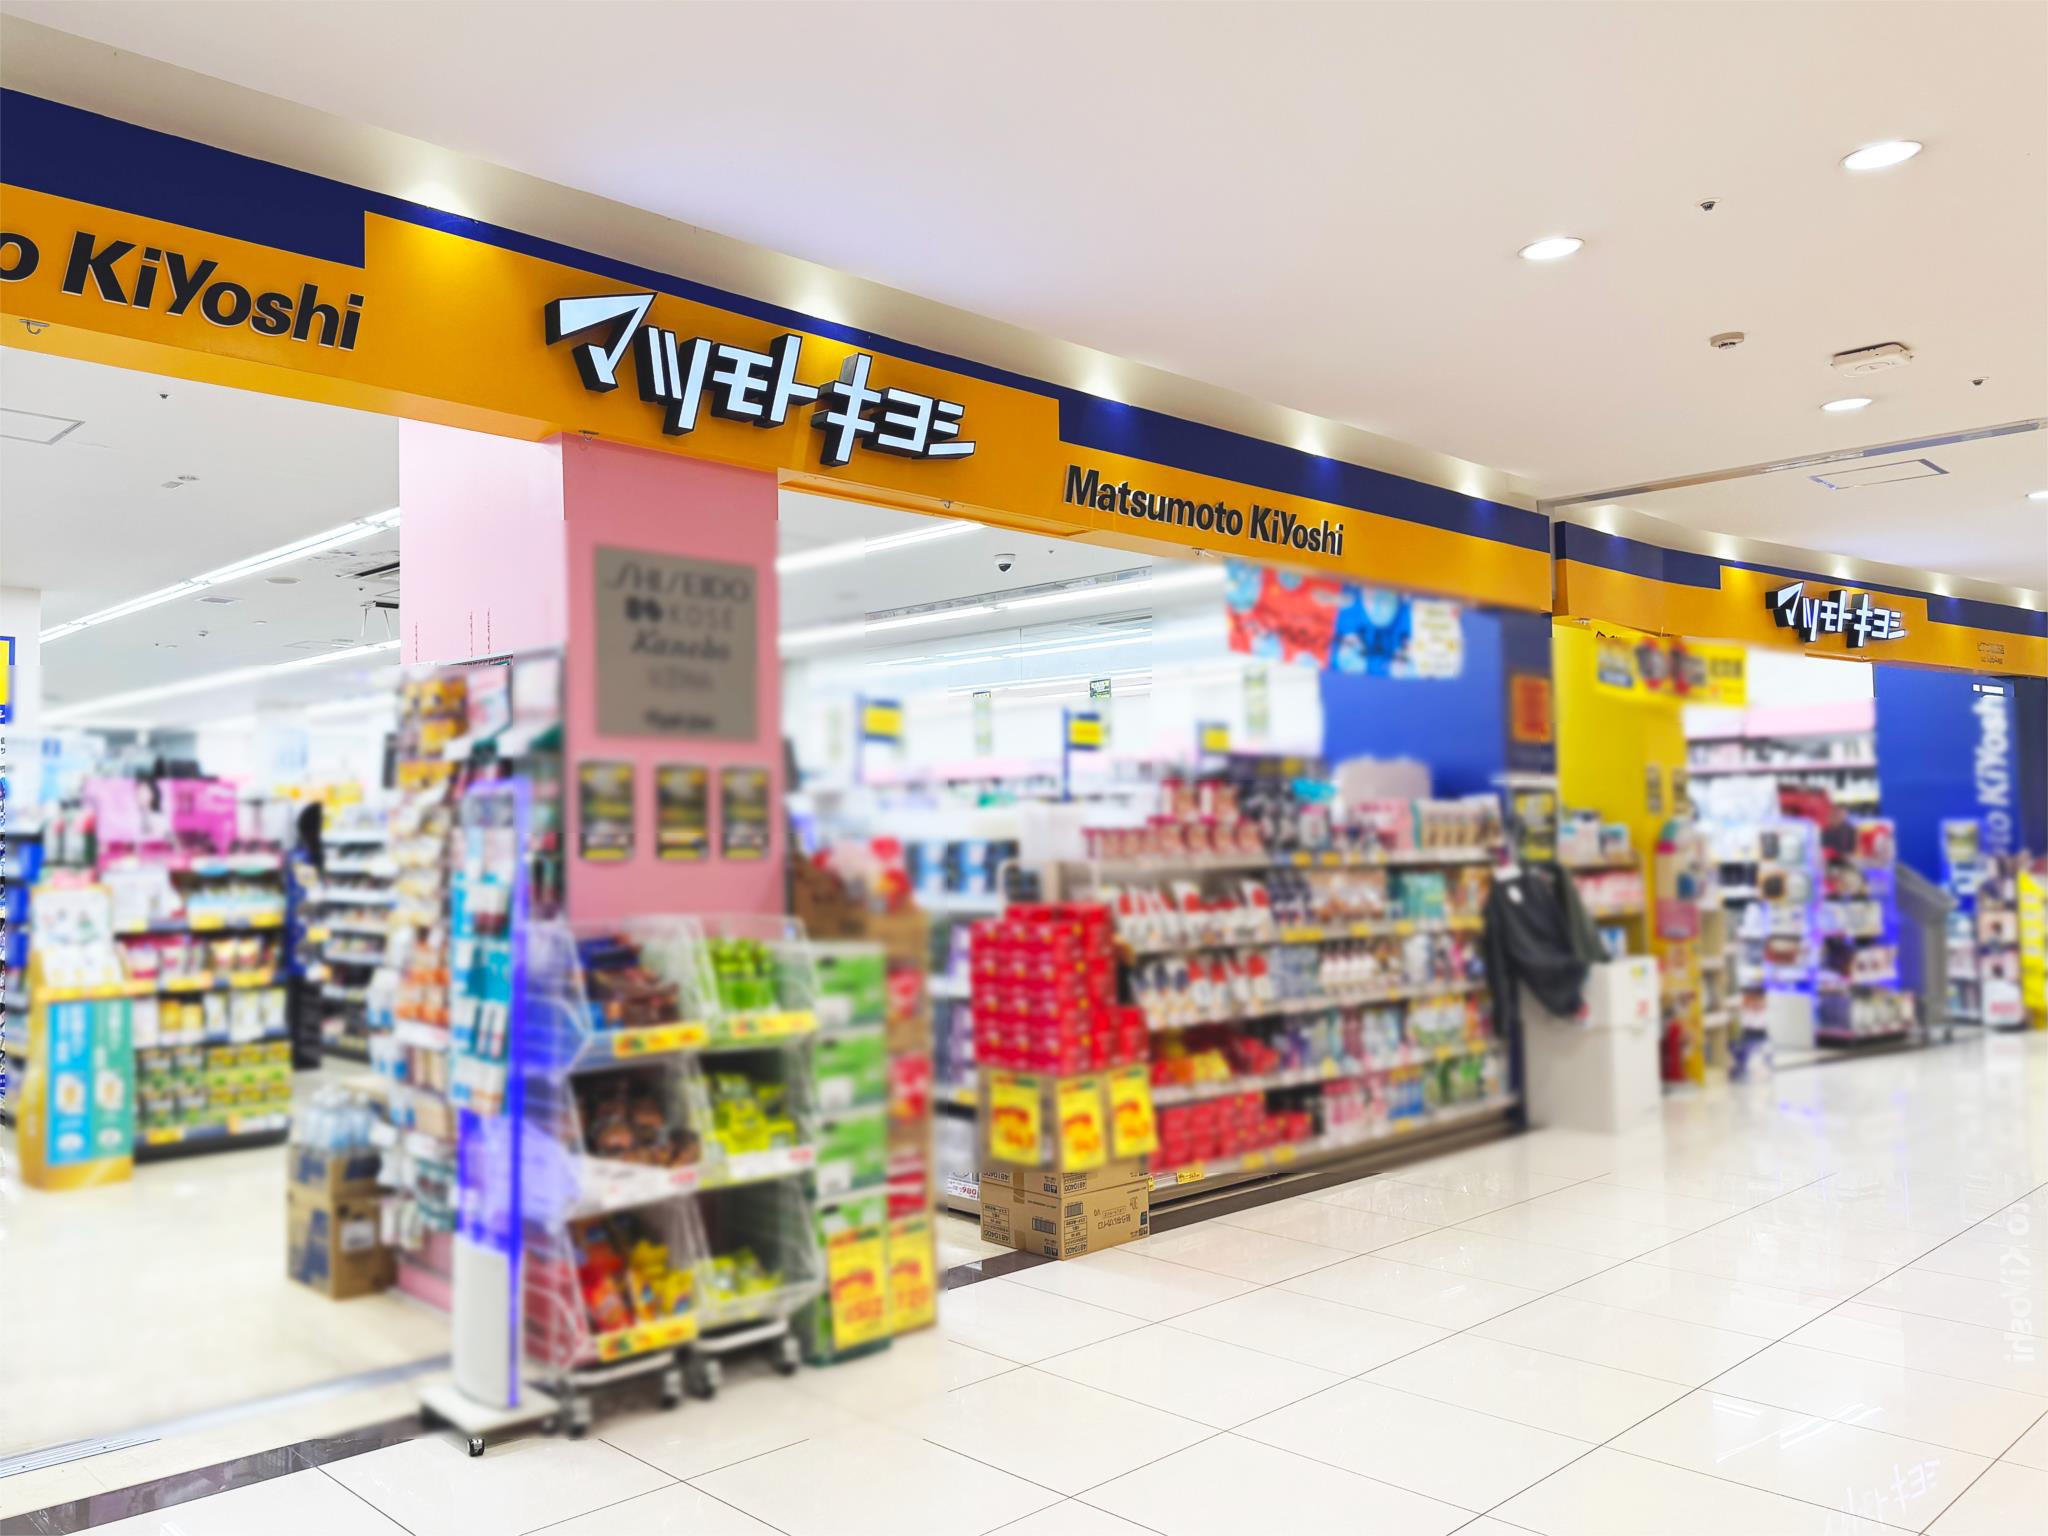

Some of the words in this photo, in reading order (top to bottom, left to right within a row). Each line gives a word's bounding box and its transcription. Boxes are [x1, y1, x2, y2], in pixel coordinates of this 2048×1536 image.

[61, 231, 365, 352] KiYoshi
[546, 291, 977, 467] マツモトキヨシ
[1063, 464, 1243, 536] Matsumoto
[1249, 503, 1345, 557] KiYoshi
[1766, 581, 1906, 648] マツモトキヨシ
[1971, 683, 2010, 804] KiYoshi
